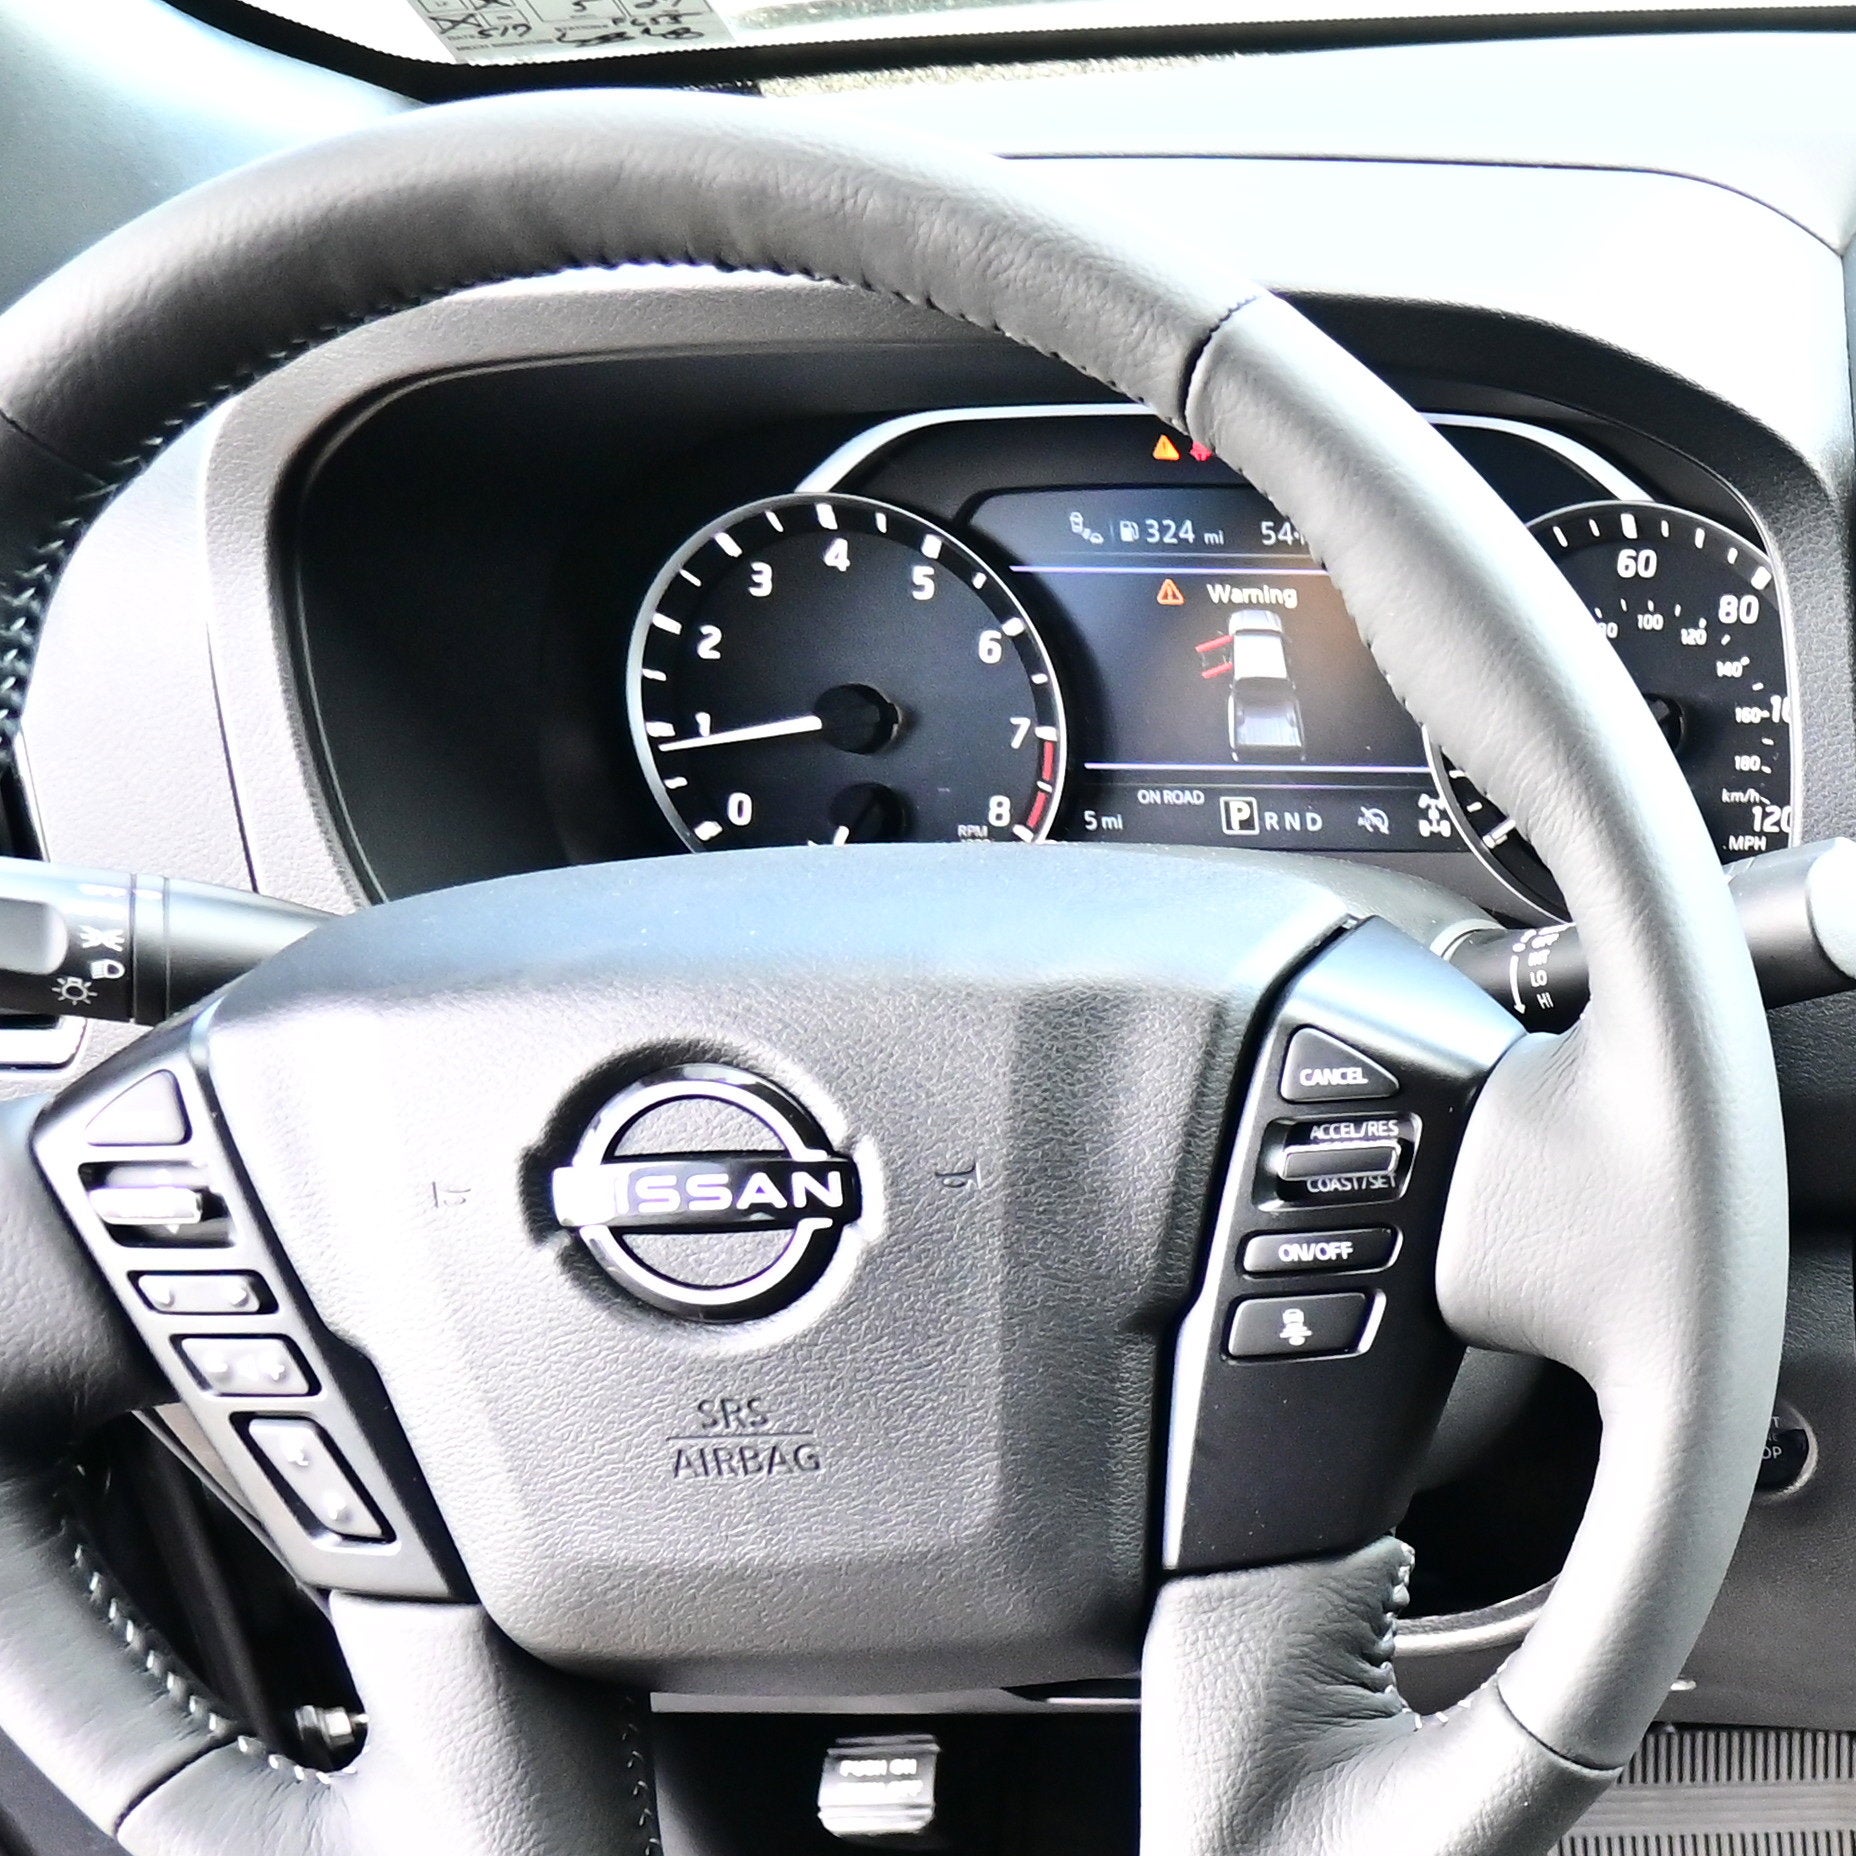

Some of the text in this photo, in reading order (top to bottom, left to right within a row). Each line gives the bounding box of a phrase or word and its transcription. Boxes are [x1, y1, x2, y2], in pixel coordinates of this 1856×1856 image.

[1144, 517, 1225, 547] 324 mi
[823, 537, 851, 572] 4
[1616, 548, 1658, 578] 60
[748, 561, 773, 597] 3
[911, 565, 935, 601] 5
[1206, 584, 1298, 609] Warning
[1718, 594, 1760, 625] 80
[1637, 613, 1664, 631] 100
[697, 624, 722, 660] 2
[978, 627, 1005, 664] 6
[1009, 716, 1031, 749] 7
[727, 792, 753, 826] 0
[985, 794, 1011, 830] 8
[1136, 788, 1206, 807] ON ROAD
[1228, 799, 1252, 832] P
[1263, 810, 1324, 832] R N D
[1727, 833, 1767, 852] MPH
[1298, 1065, 1370, 1087] CANCEL
[1309, 1119, 1400, 1141] ACCEL/RES
[562, 1168, 845, 1216] ISSAN
[1306, 1174, 1397, 1194] COAST/SET
[1277, 1241, 1354, 1263] ON/OFF
[697, 1397, 770, 1431] SRS
[674, 1442, 822, 1480] AIRBAG
